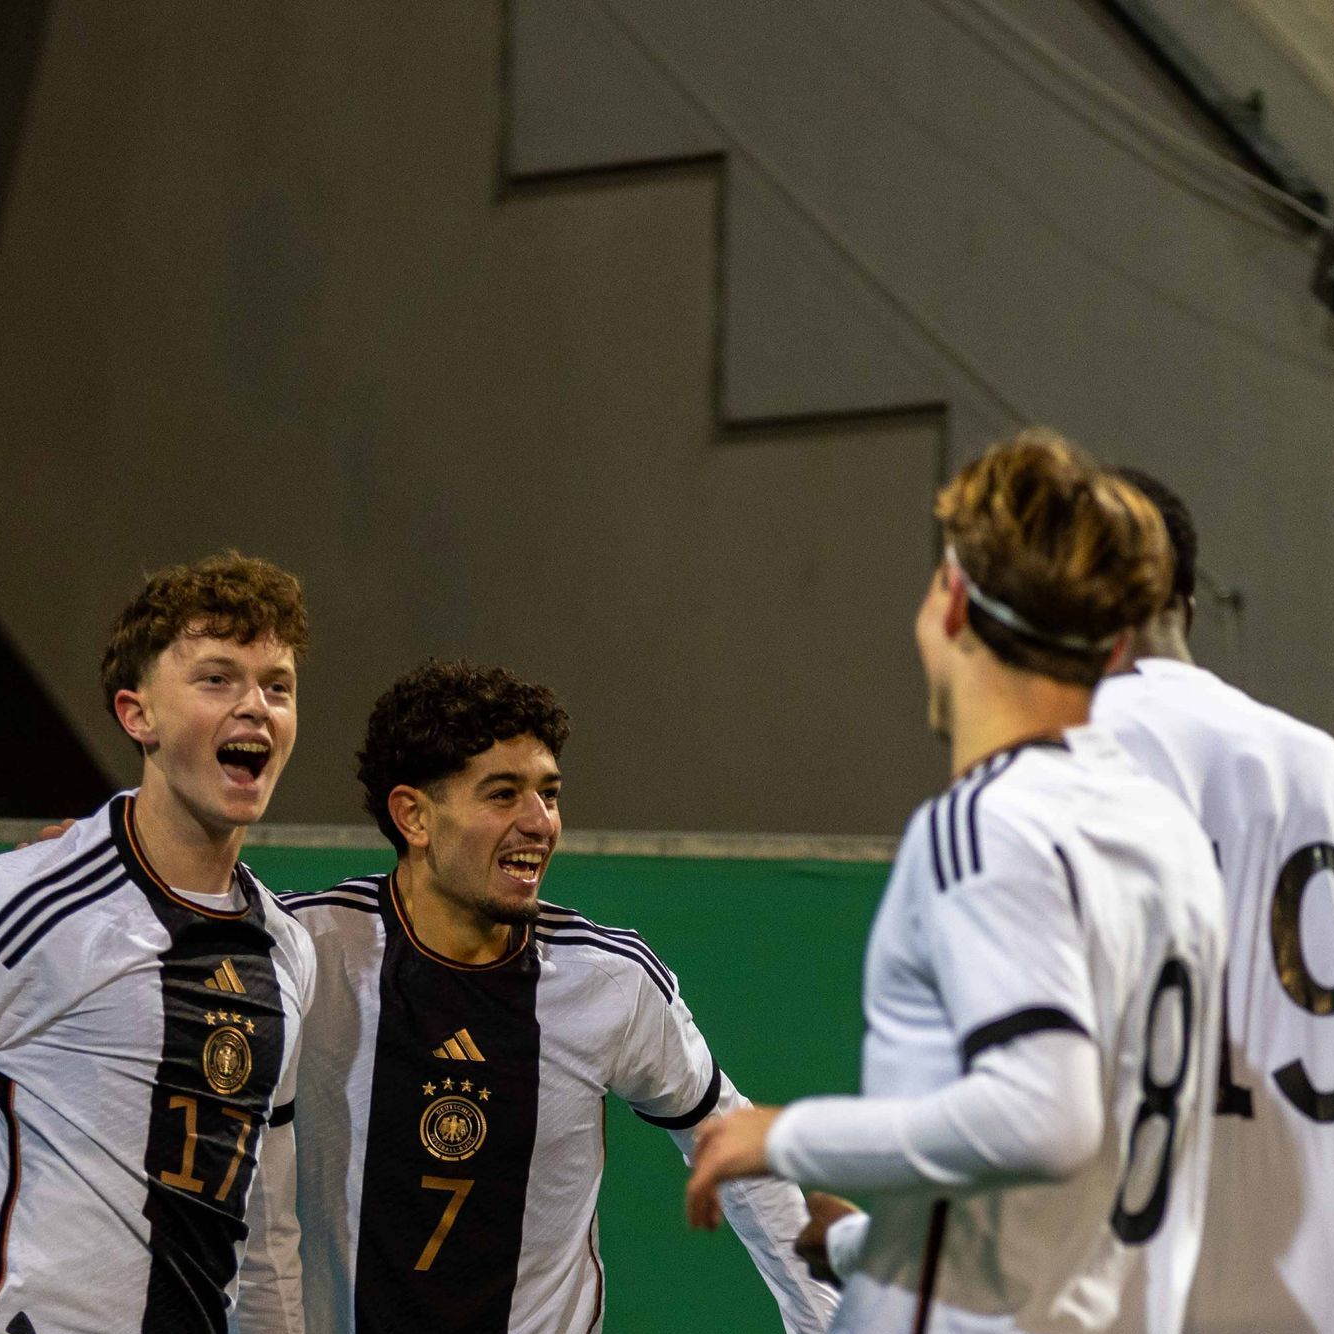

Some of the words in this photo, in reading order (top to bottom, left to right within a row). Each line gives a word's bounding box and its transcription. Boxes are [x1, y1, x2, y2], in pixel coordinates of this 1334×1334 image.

[160, 1095, 251, 1201] 17
[1110, 958, 1194, 1247] 8
[414, 1174, 475, 1272] 7
